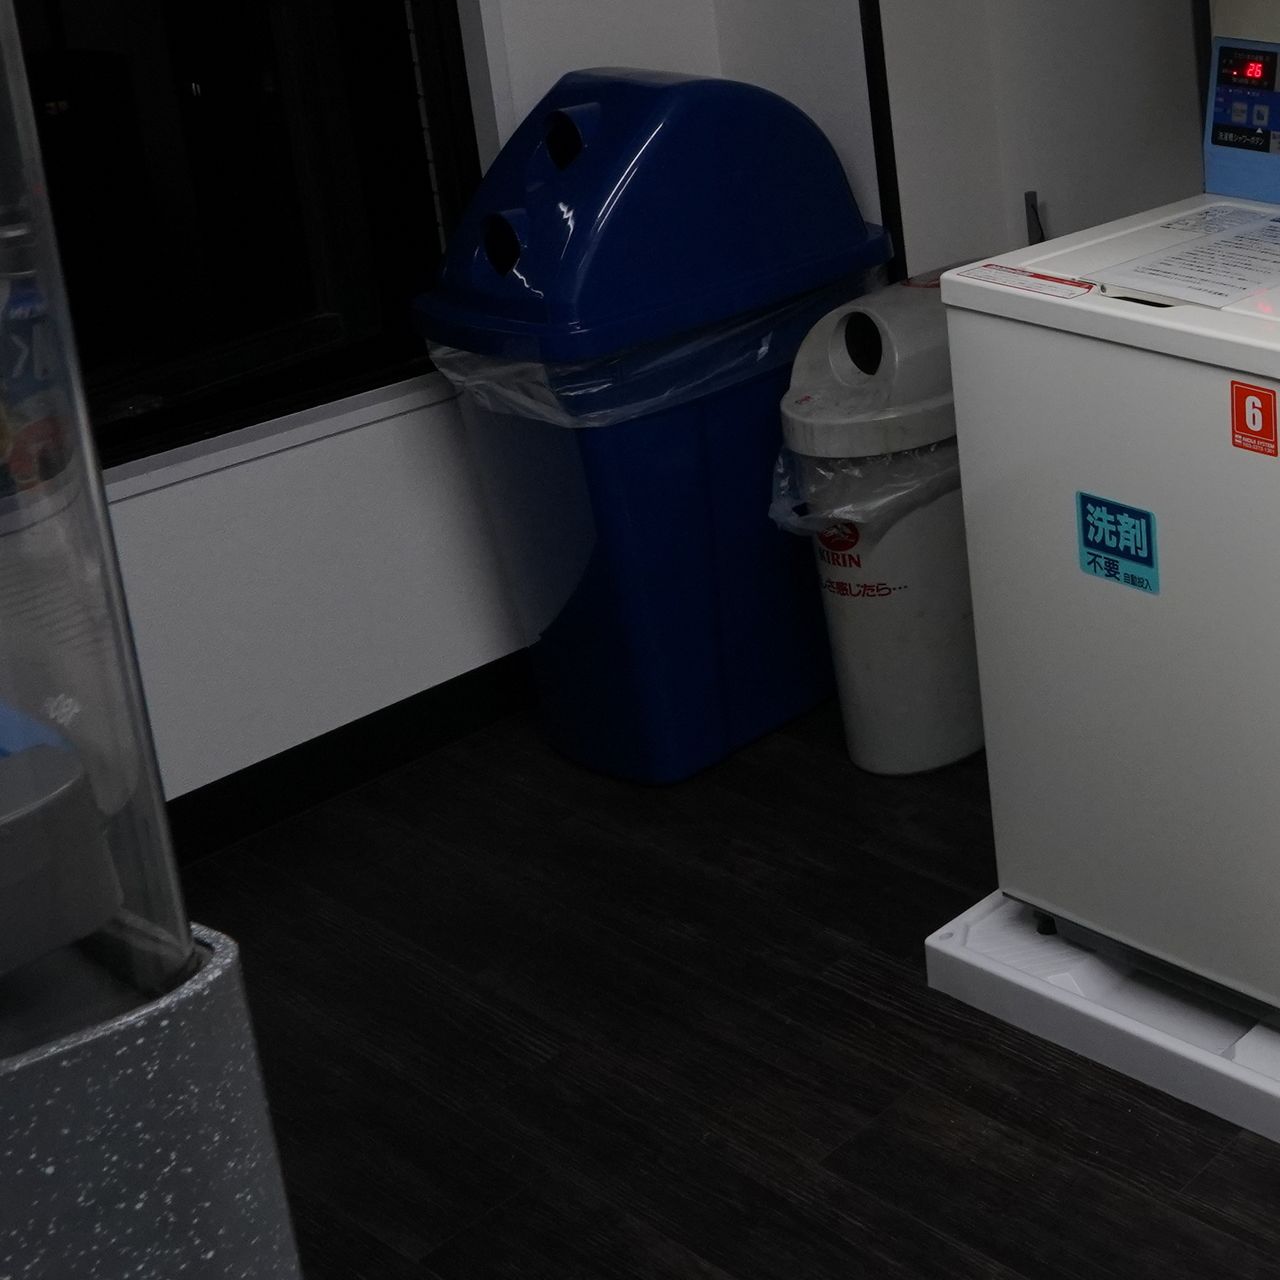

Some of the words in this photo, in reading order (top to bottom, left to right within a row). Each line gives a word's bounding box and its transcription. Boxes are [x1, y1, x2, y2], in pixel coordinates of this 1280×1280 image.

[1246, 64, 1262, 77] 26
[1245, 396, 1263, 432] 6
[1086, 503, 1148, 557] 洗剤
[820, 548, 861, 568] KIRIN
[1087, 551, 1120, 580] 不要
